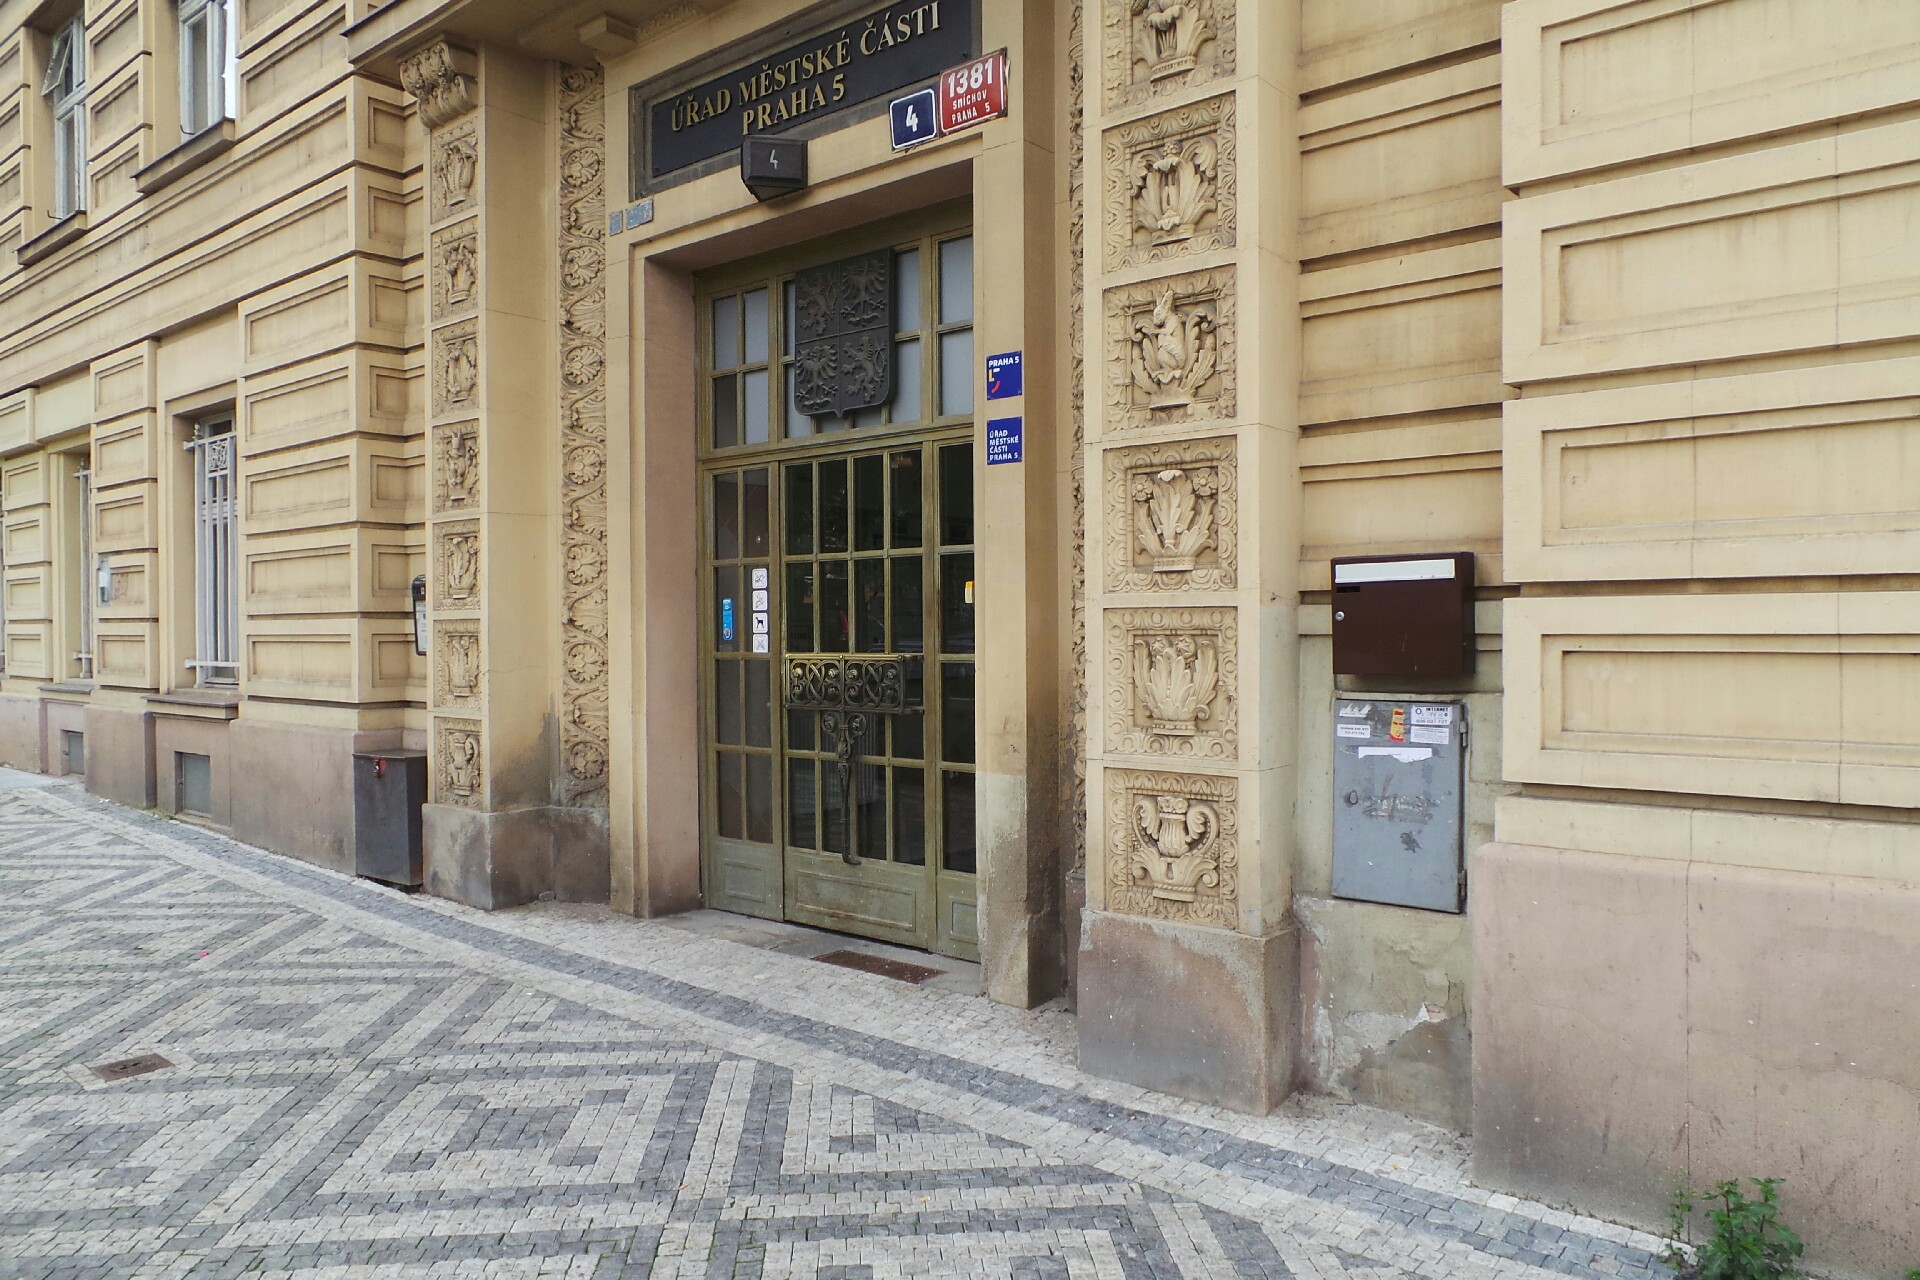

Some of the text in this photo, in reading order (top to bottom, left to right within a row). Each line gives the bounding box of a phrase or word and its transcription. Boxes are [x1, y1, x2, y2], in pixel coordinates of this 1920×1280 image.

[671, 1, 940, 132] ÚŘAD MĚSTSKÉ ČÁSTI
[948, 58, 993, 98] 1381
[742, 73, 845, 135] PRAHA 5
[952, 89, 987, 110] SMÍCHOV
[906, 105, 918, 132] 4
[951, 102, 991, 124] PRAHA 5
[770, 149, 778, 169] 4
[988, 356, 1020, 368] PRAHA 5
[989, 429, 1008, 438] ÚŘAD
[989, 435, 1019, 446] MĚSTSKÉ
[989, 444, 1008, 454] ČÁSTI
[989, 452, 1012, 461] PRAHA
